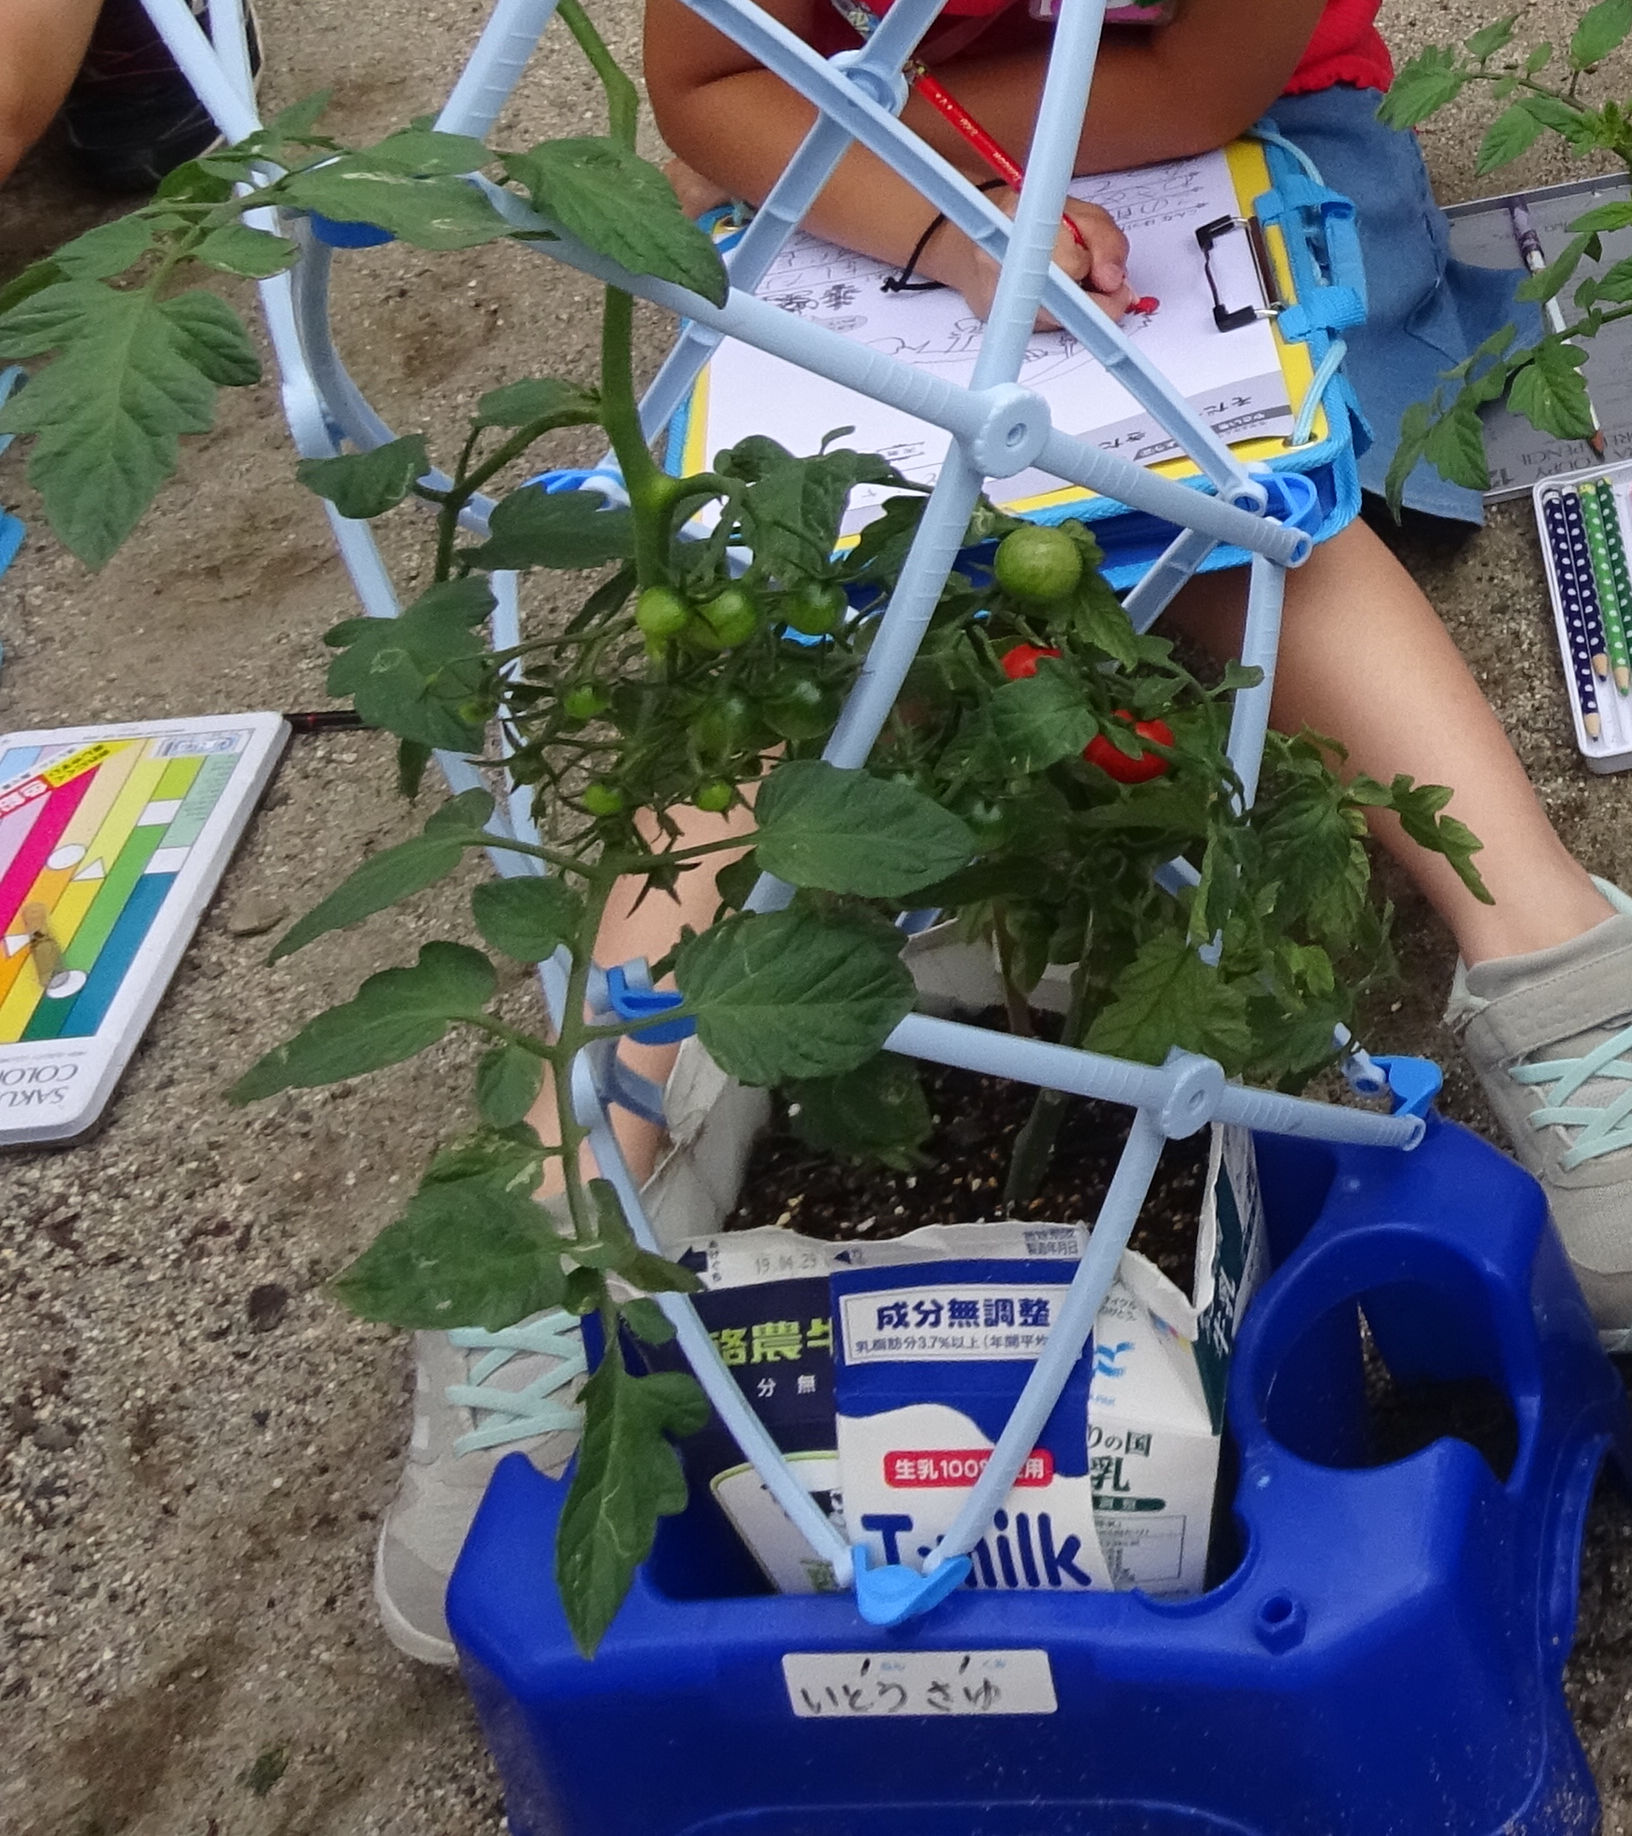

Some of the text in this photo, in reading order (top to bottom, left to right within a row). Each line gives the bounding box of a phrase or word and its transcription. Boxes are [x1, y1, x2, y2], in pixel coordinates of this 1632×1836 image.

[1197, 396, 1252, 417] そだ
[875, 1297, 1051, 1332] 成分無調整
[800, 1677, 1002, 1714] いとう さゆ
